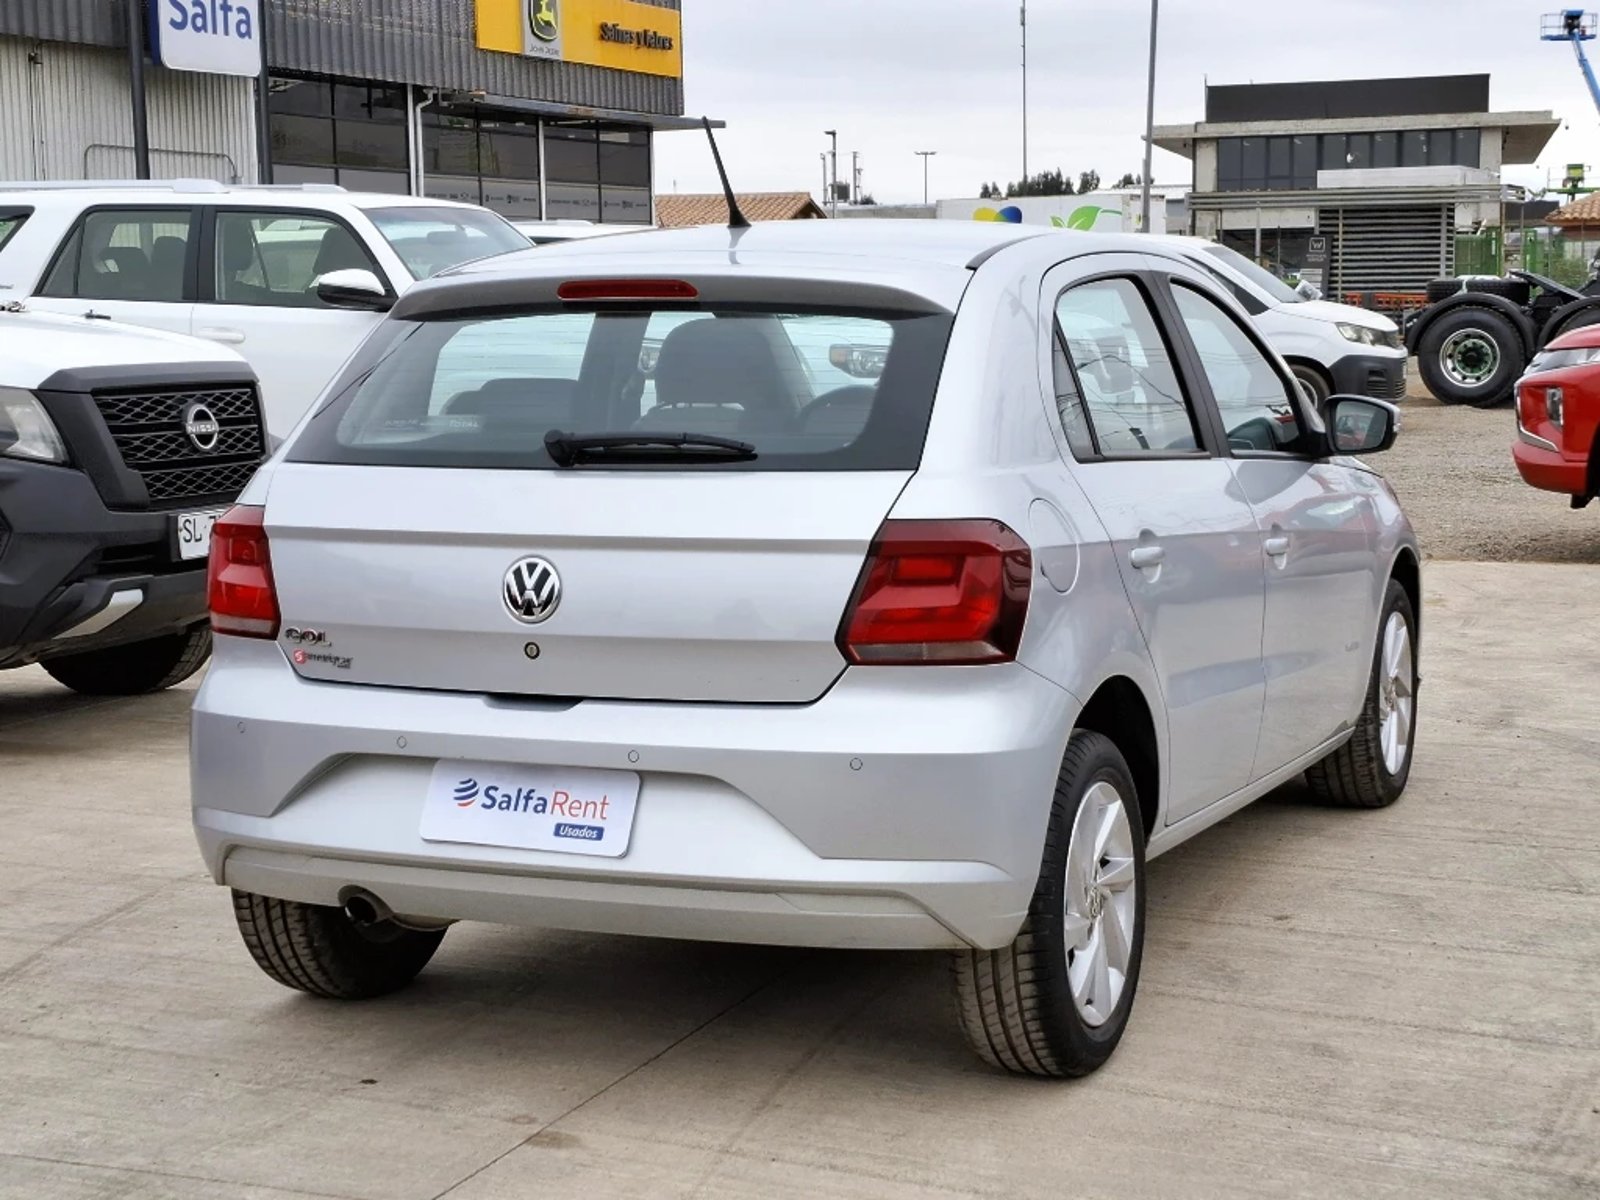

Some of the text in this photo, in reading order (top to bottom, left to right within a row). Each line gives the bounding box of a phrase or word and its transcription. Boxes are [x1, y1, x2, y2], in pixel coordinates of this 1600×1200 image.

[168, 0, 252, 40] Salfa
[284, 626, 332, 648] GOL
[481, 785, 610, 820] SalfaRent
[559, 824, 599, 839] Usados
